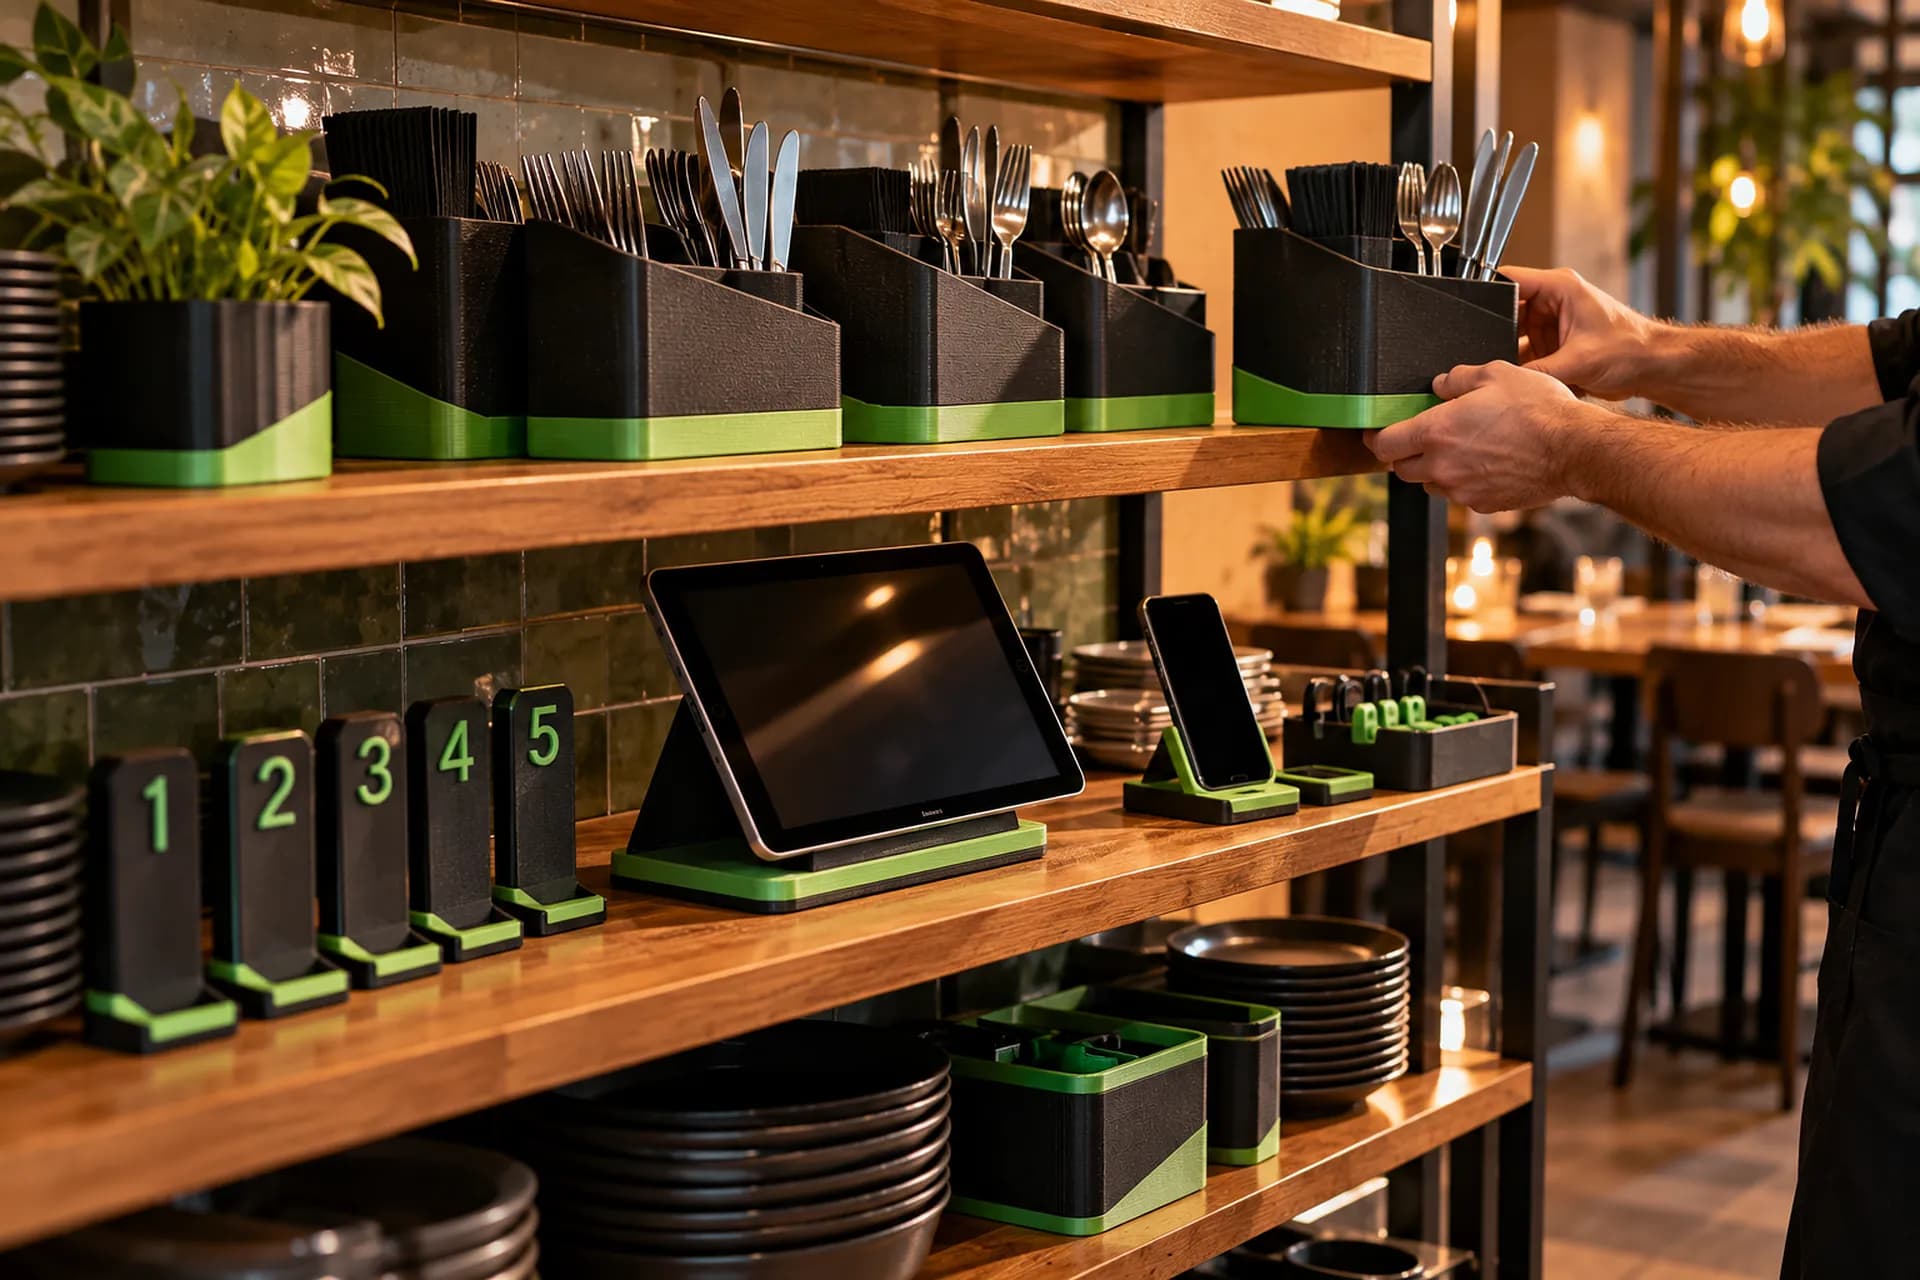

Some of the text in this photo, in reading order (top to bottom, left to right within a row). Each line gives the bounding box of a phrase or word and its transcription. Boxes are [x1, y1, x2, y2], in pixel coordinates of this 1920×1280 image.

[439, 720, 474, 782] 4
[528, 704, 560, 766] 5
[258, 756, 296, 830] 2
[357, 736, 393, 805] 3
[143, 775, 169, 853] 1
